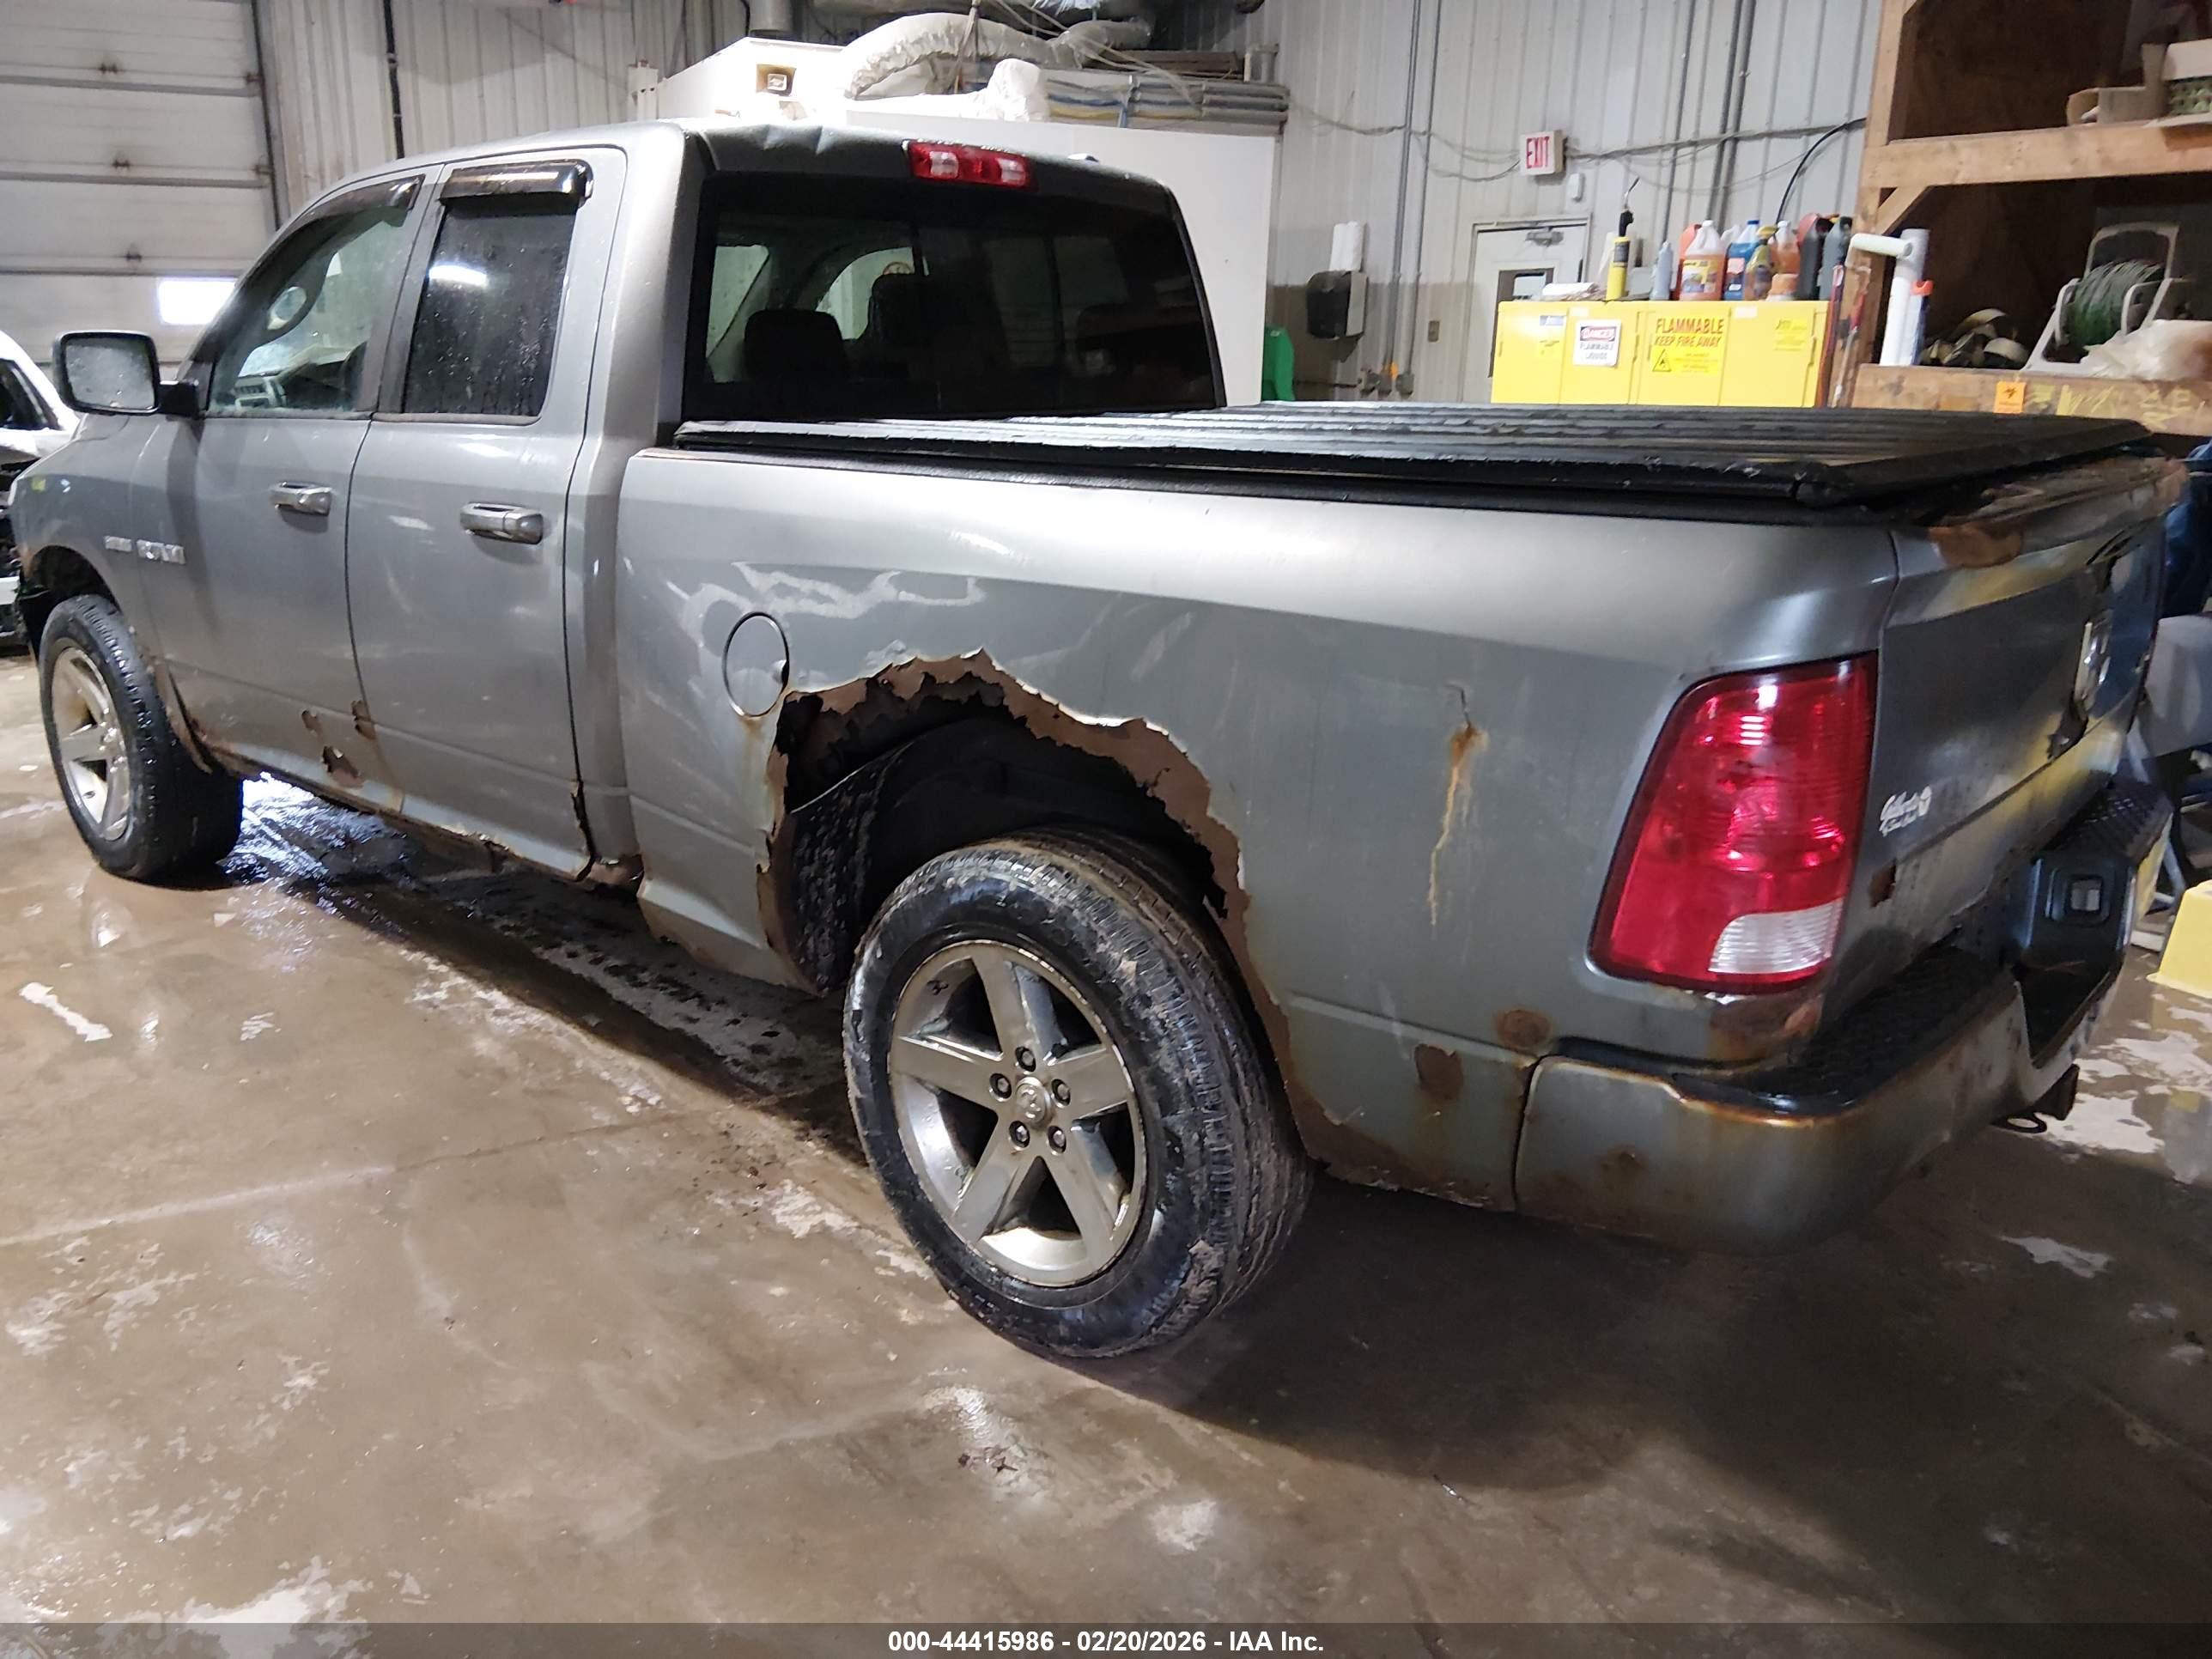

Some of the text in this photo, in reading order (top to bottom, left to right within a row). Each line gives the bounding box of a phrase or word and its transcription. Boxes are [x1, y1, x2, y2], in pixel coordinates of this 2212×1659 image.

[1526, 137, 1550, 169] EXIT
[1656, 318, 1724, 334] FLAMMABLE
[1654, 336, 1722, 348] KEEP FIRE AWAY
